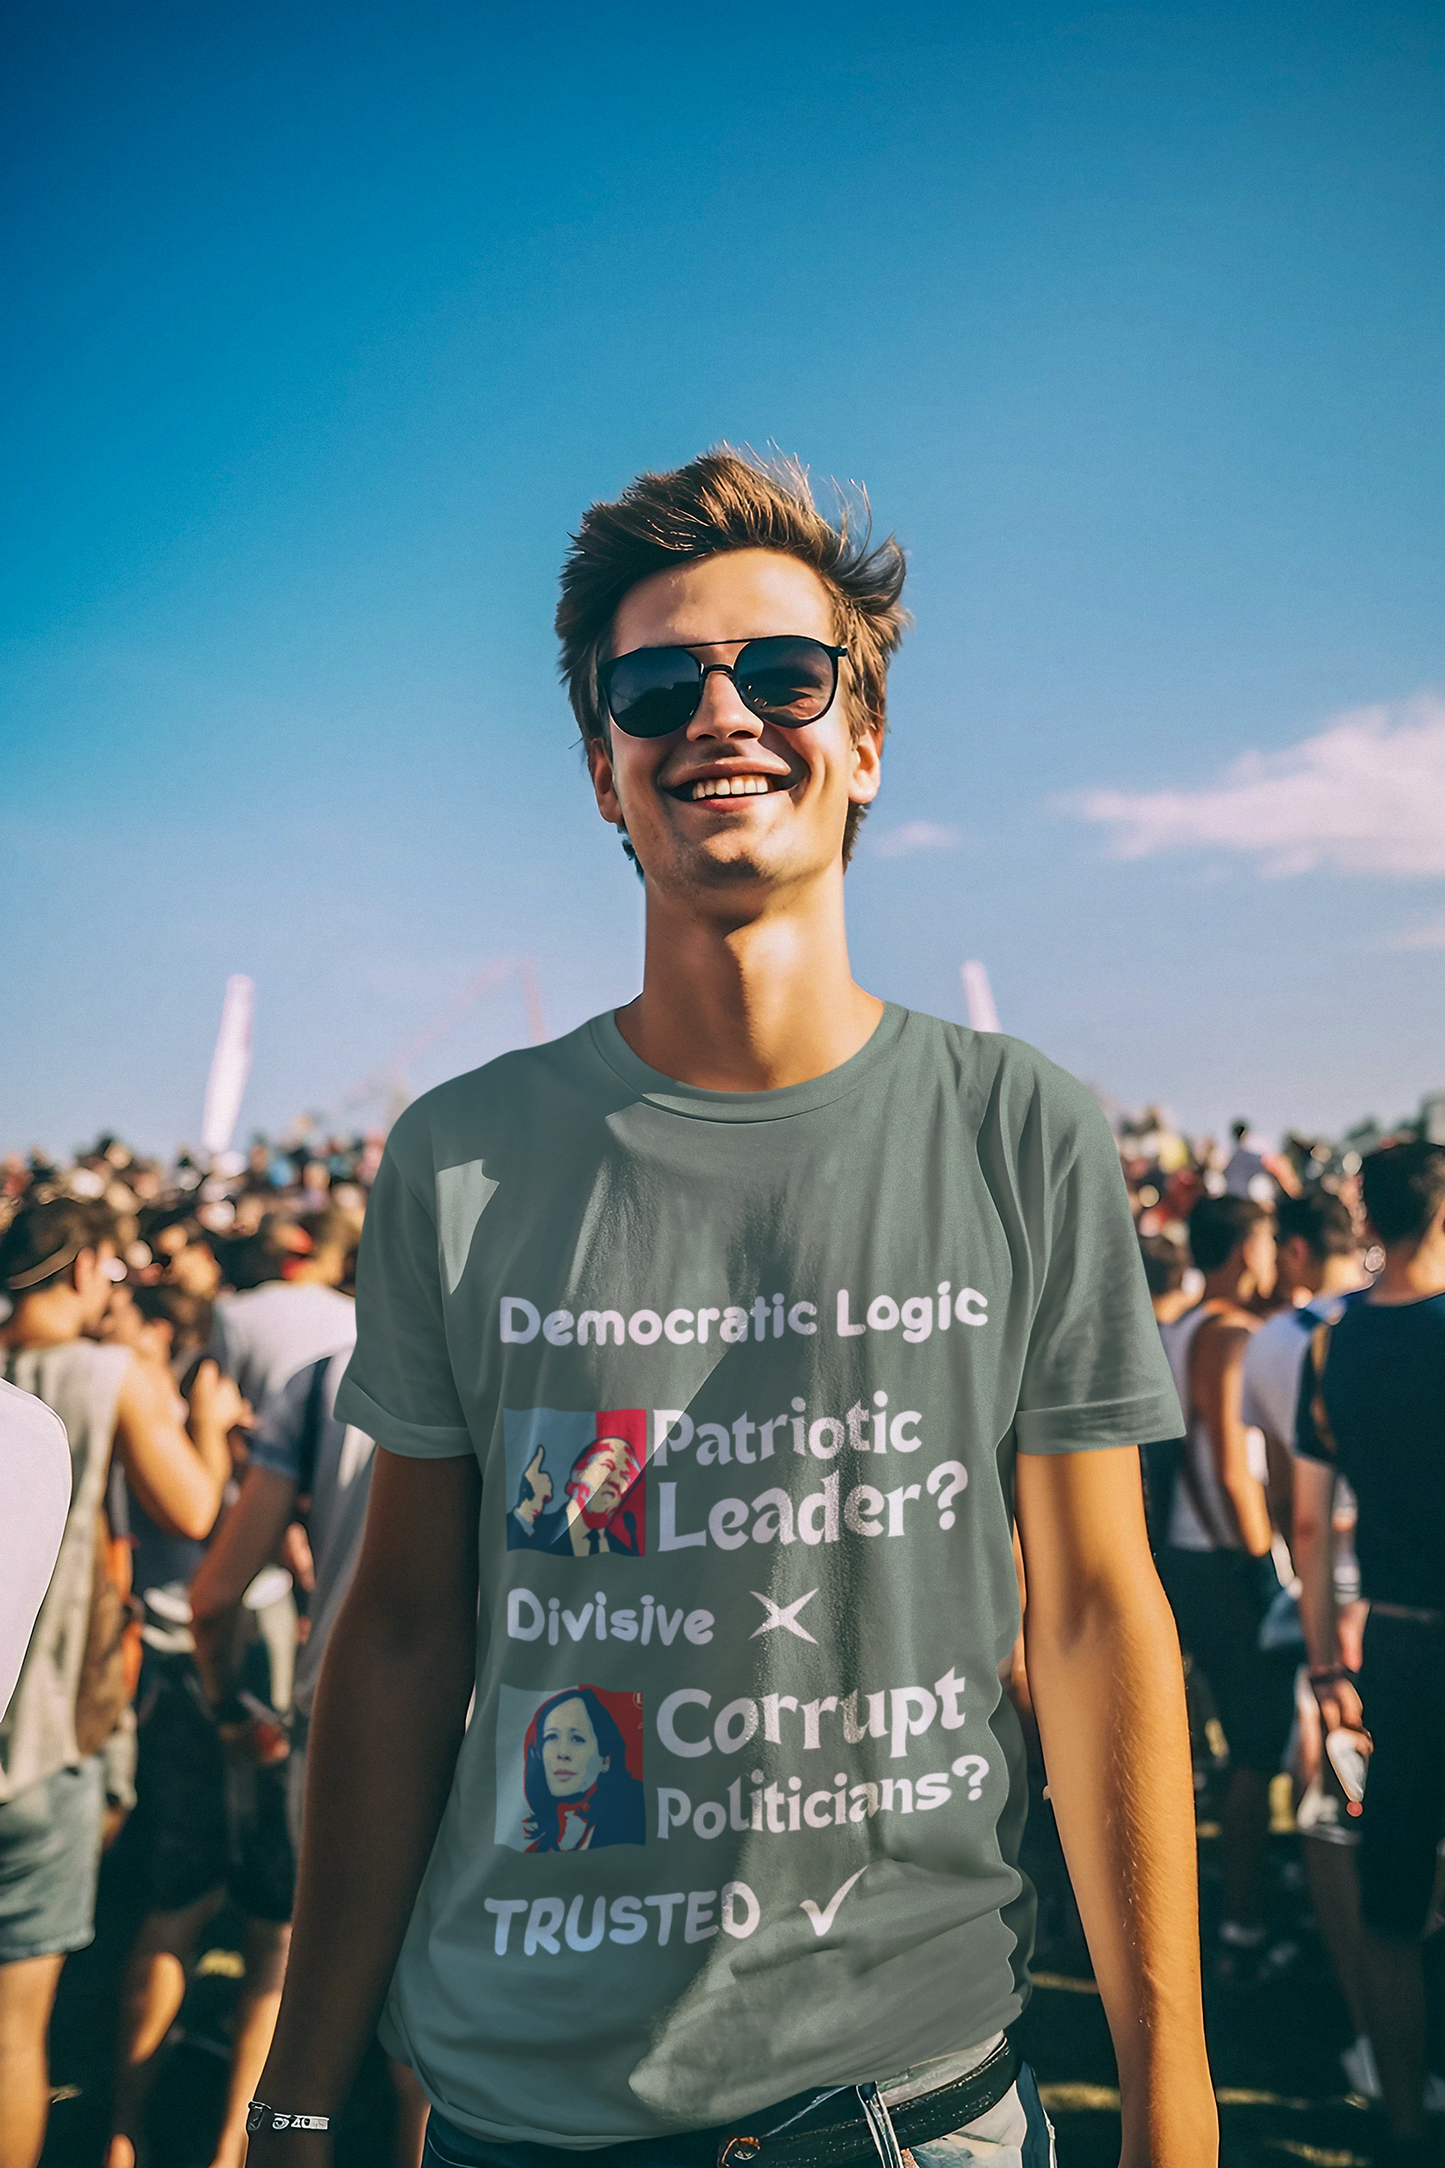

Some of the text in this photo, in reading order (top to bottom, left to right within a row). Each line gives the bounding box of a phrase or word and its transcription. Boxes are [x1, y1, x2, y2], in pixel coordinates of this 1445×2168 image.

[500, 1280, 989, 1346] Democratic Logic
[653, 1390, 923, 1467] Patriotic
[657, 1460, 969, 1552] Leader?
[507, 1588, 715, 1646] Divisive
[656, 1666, 967, 1758] Corrupt
[656, 1755, 990, 1839] Politicians?
[484, 1881, 761, 1956] TRUSTED
